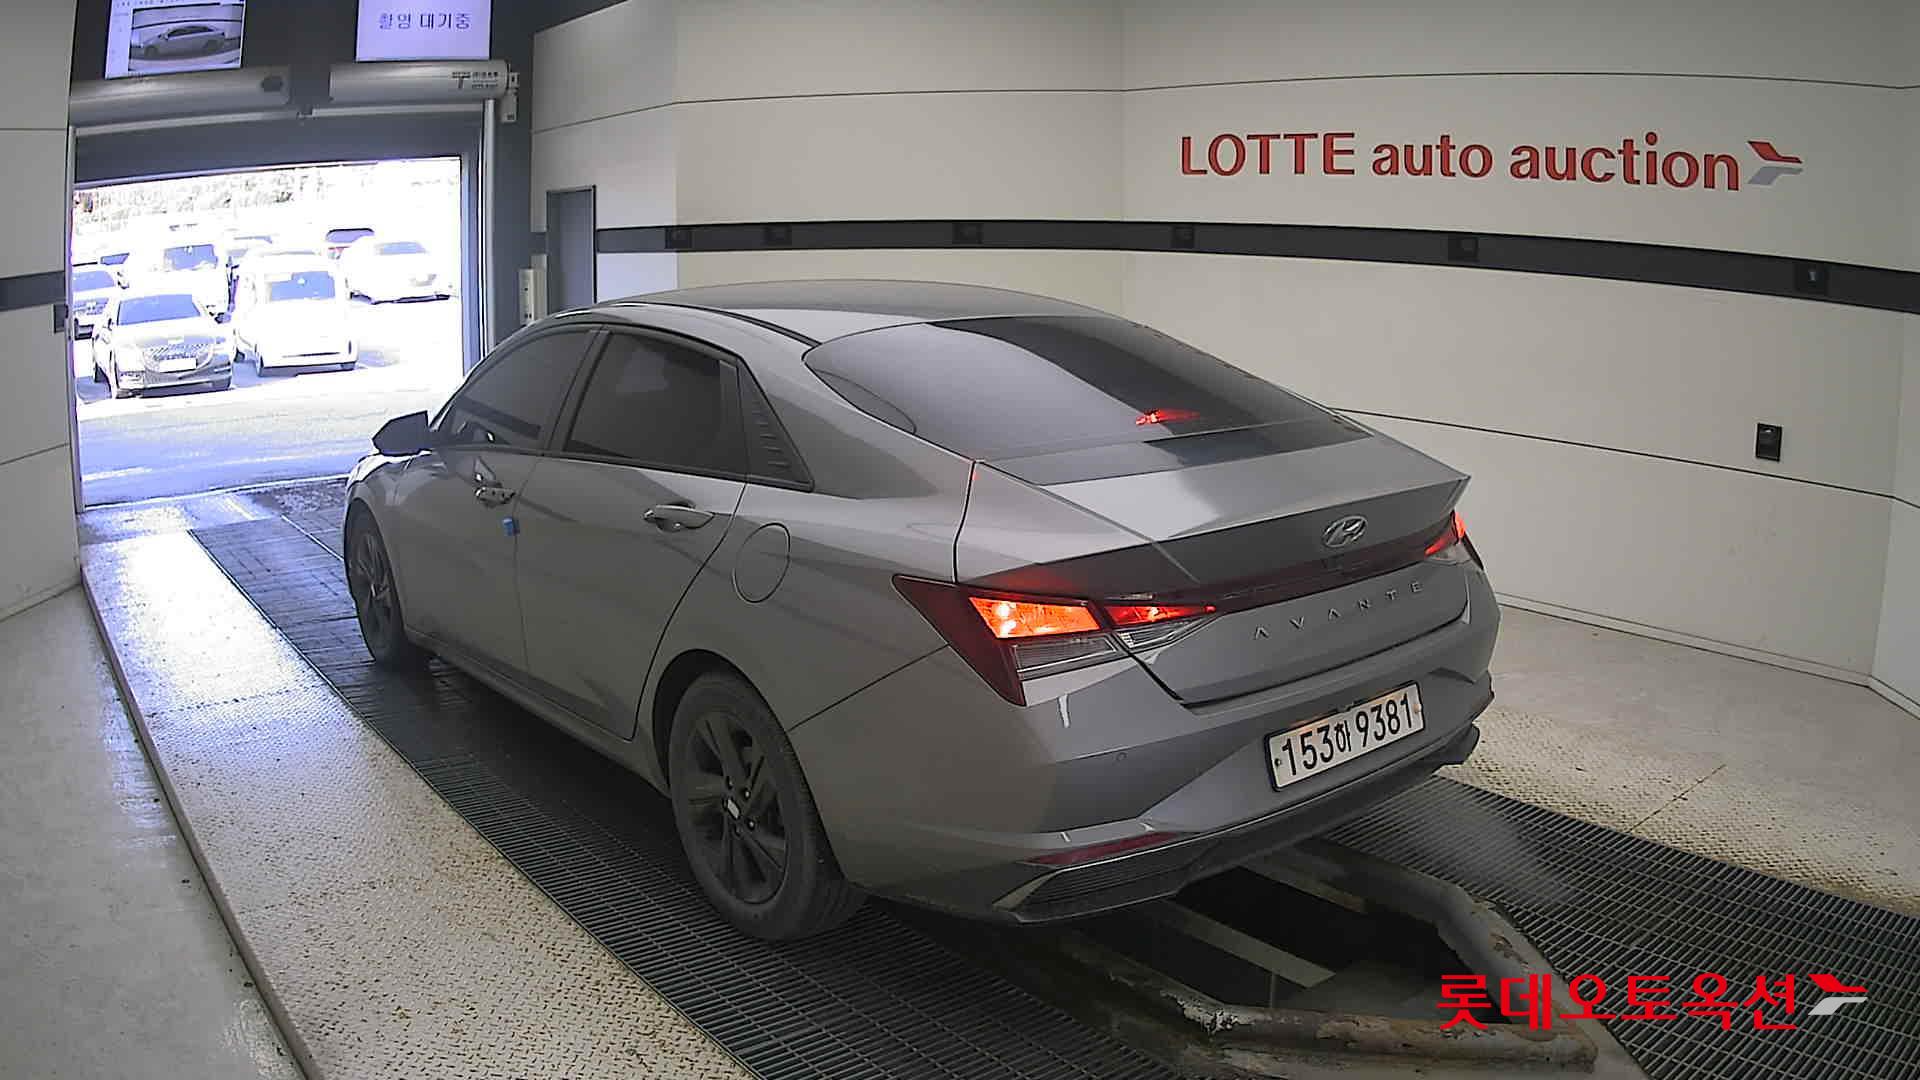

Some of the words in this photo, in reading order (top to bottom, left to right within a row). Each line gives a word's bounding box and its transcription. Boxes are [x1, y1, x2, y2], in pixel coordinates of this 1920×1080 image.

[419, 12, 472, 30] 대기중
[1180, 132, 1356, 176] LOTTE
[1371, 133, 1494, 178] auto
[1509, 131, 1740, 191] auction
[1253, 581, 1424, 640] AVANTE
[1355, 692, 1413, 748] 9381
